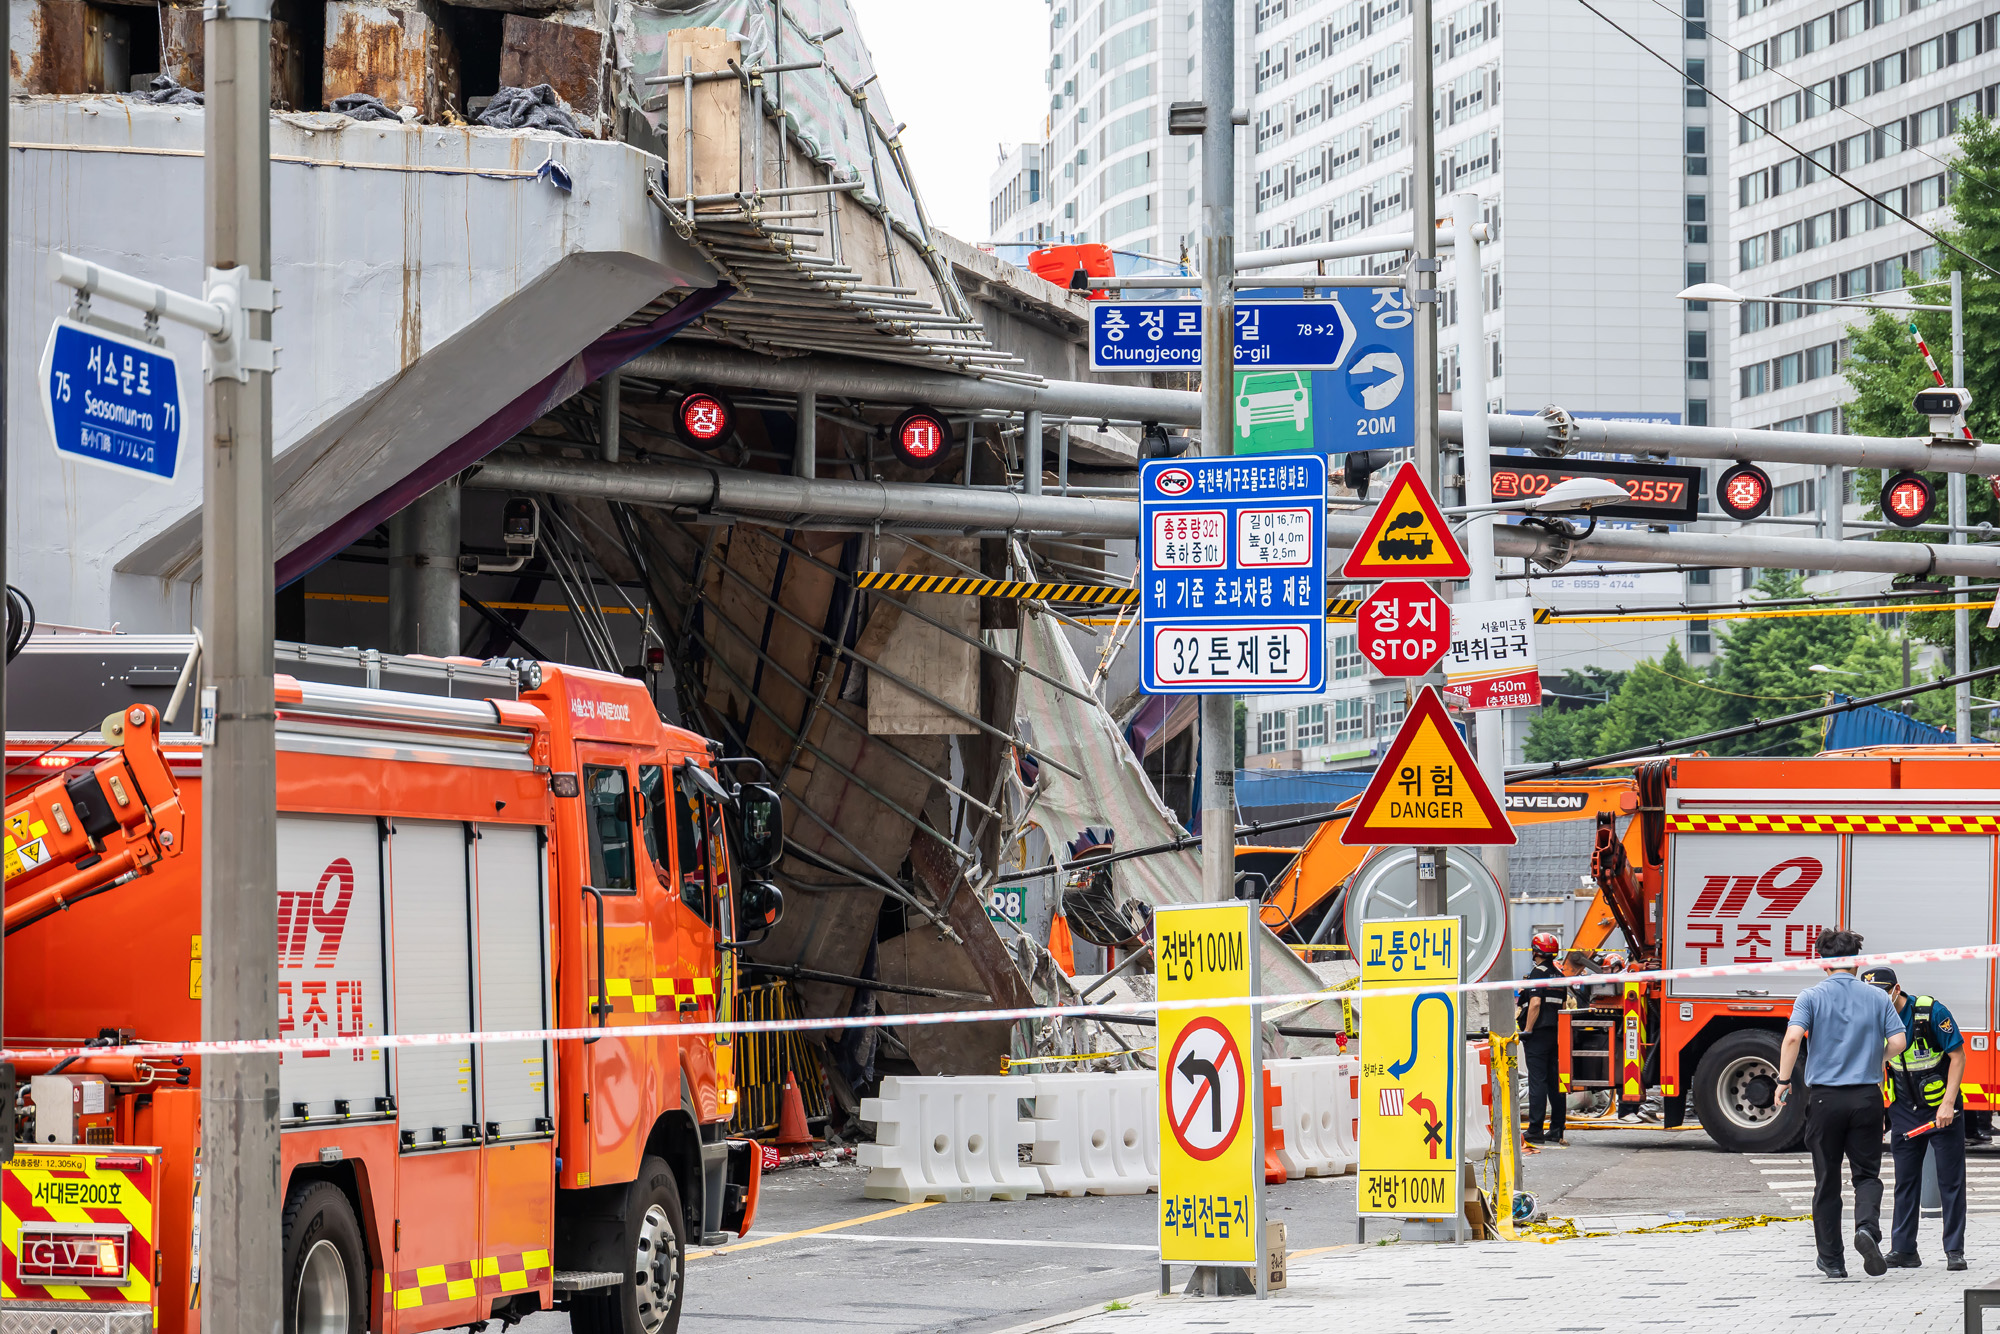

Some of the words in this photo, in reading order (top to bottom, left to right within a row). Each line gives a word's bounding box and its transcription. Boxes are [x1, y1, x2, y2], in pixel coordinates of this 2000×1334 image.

[1101, 309, 1260, 341] 충정로길
[1101, 346, 1201, 362] Chungjeong
[87, 345, 151, 396] 서소문로
[55, 371, 71, 403] 75
[84, 390, 153, 431] Seosomun-ro
[163, 403, 176, 432] 71
[693, 407, 717, 432] 정
[909, 427, 933, 450] 지
[1357, 416, 1396, 436] 20M
[1733, 481, 1757, 509] 정
[1897, 490, 1919, 512] 지
[1251, 513, 1274, 529] 길이
[1277, 514, 1304, 526] 16.7m
[1249, 532, 1275, 548] 높이
[1279, 532, 1304, 544] 4.0m
[1259, 547, 1270, 562] 폭
[1272, 548, 1296, 560] 2.5m
[1154, 578, 1166, 608] 위
[1177, 577, 1204, 608] 기준
[1215, 576, 1272, 608] 초과차량
[1283, 575, 1311, 606] 제한
[1371, 598, 1436, 632] 정지
[1481, 618, 1527, 633] 서울미근동
[1371, 639, 1437, 662] STOP
[1446, 635, 1528, 663] 편취급국
[1490, 680, 1526, 693] 450m
[1486, 693, 1531, 707] (충정타워)
[1398, 764, 1453, 797] 위험
[1391, 801, 1463, 818] DANGER
[1505, 796, 1582, 808] DEVELON
[1687, 856, 1823, 918] 119
[1162, 930, 1243, 981] 전방100M
[1367, 927, 1451, 972] 교통안내
[1685, 923, 1822, 965] 구조대
[1363, 1063, 1385, 1077] 청파로
[35, 1183, 122, 1204] 서대문200호
[1368, 1175, 1445, 1208] 전방100M
[1165, 1194, 1249, 1239] 좌회전금지
